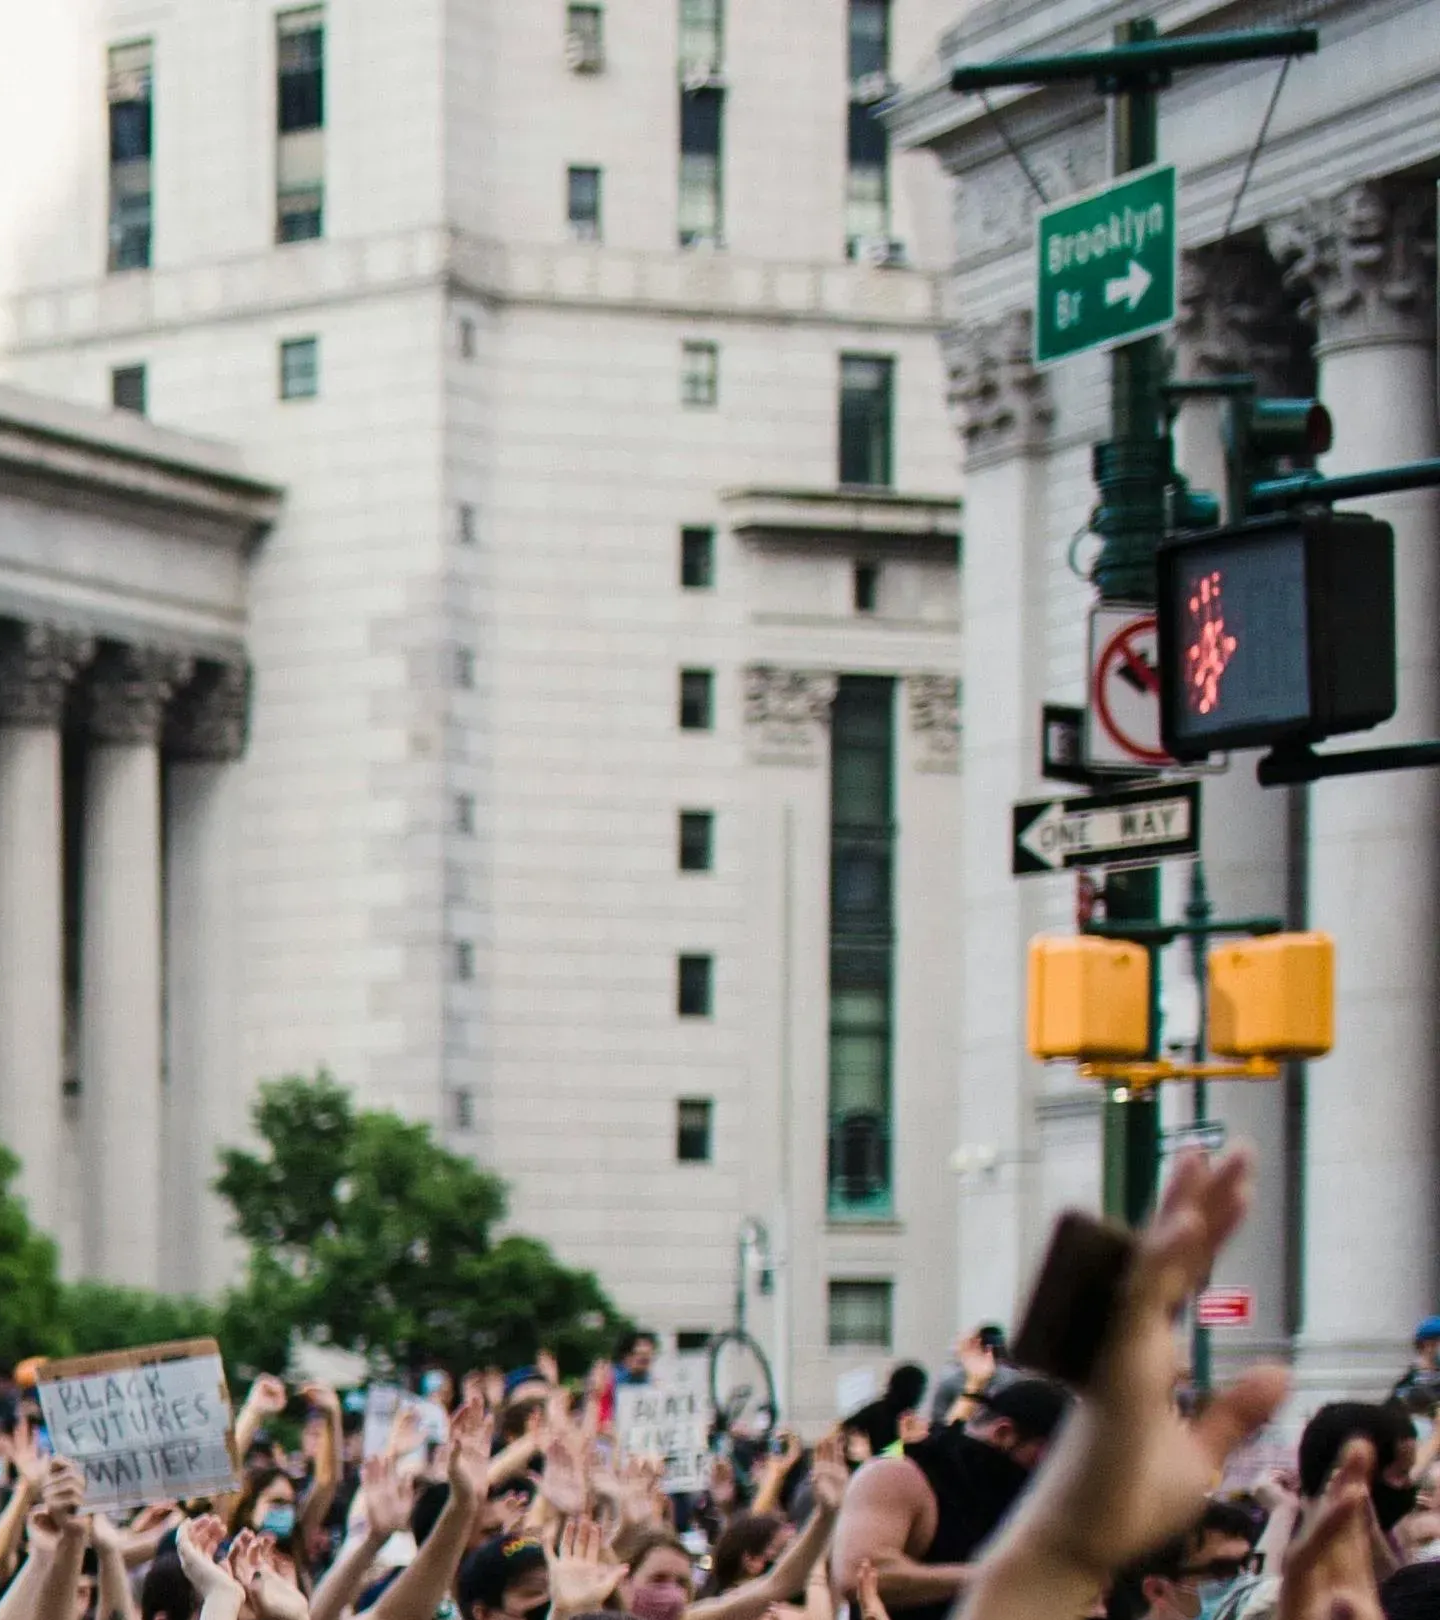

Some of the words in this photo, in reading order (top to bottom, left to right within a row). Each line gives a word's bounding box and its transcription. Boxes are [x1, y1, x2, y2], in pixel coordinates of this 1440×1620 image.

[1048, 202, 1164, 276] Brooklyn
[1056, 289, 1082, 331] Br
[1040, 819, 1089, 849] ONE
[1121, 806, 1180, 837] WAY
[57, 1361, 166, 1415] BLACK
[67, 1393, 209, 1446] FUTURES
[84, 1444, 202, 1487] MATTER
